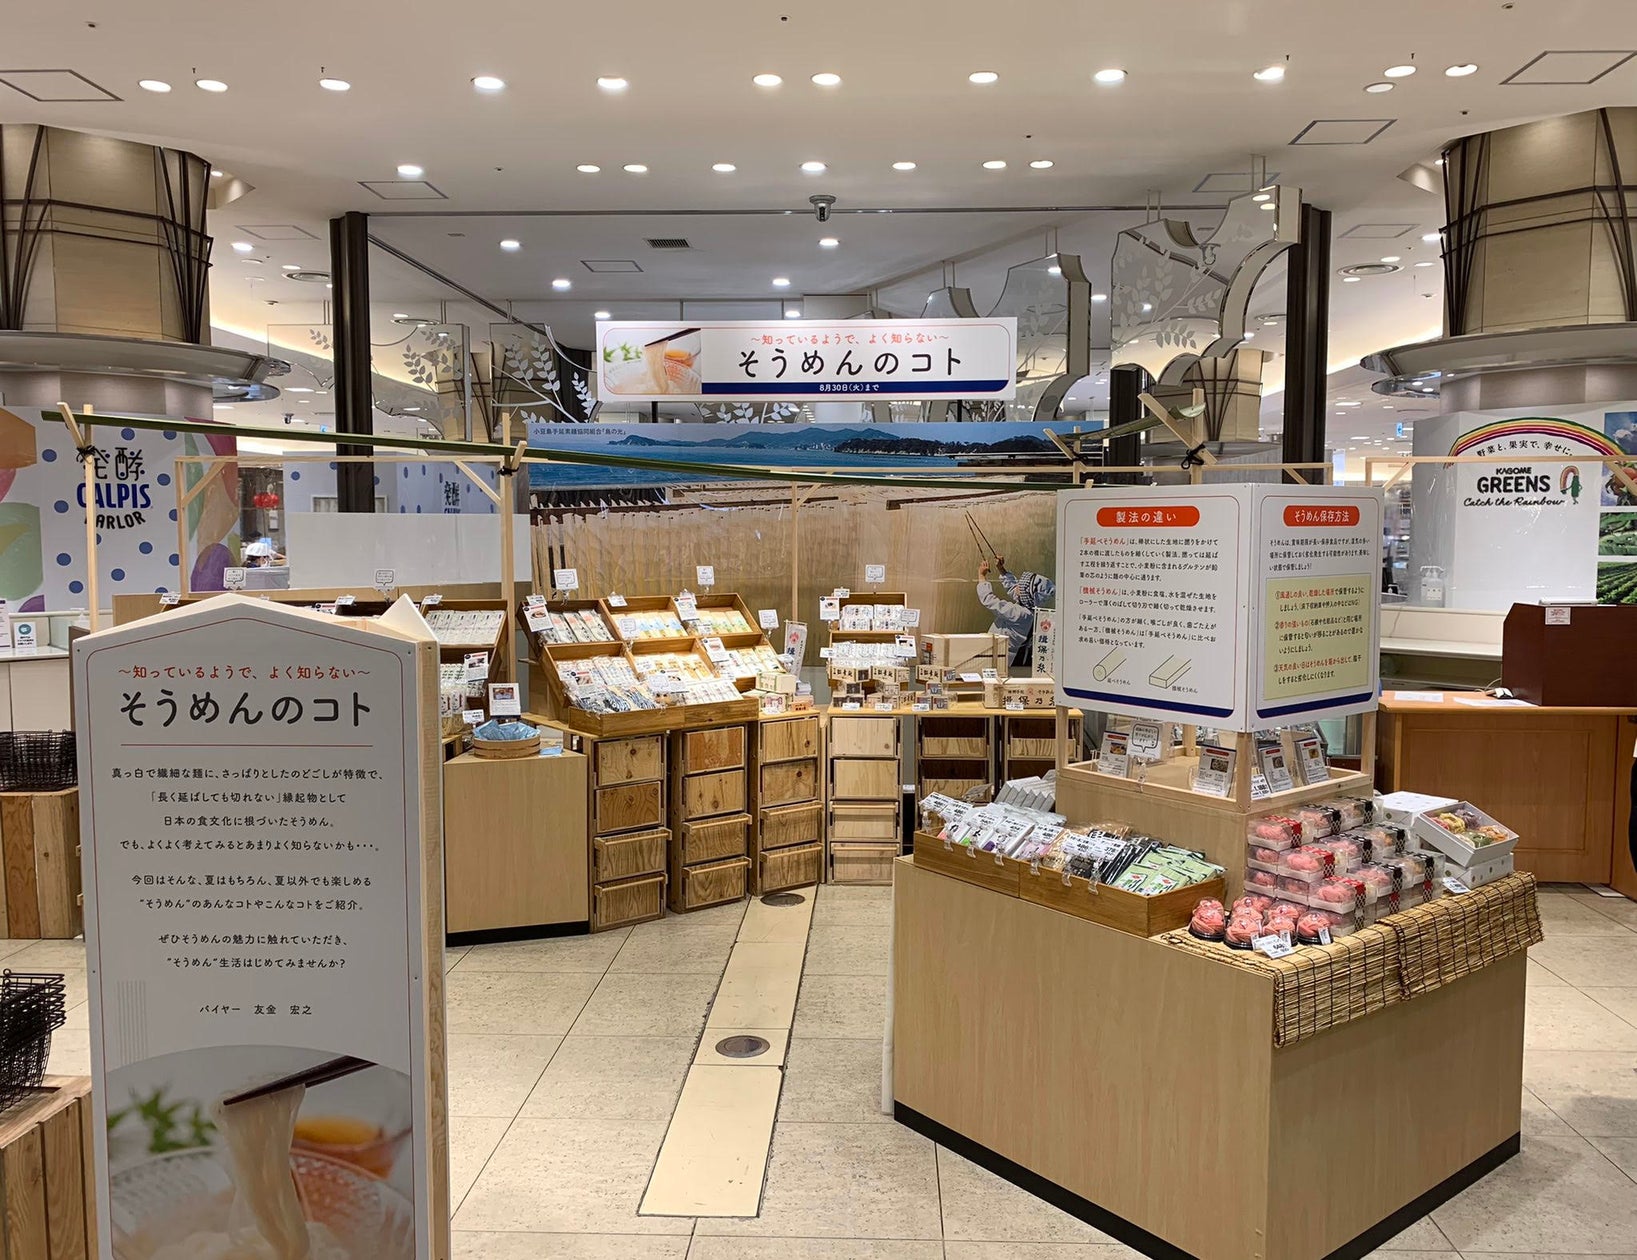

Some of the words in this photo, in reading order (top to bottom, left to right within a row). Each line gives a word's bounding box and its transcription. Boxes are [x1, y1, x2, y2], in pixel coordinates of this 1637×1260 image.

[738, 348, 962, 378] そうめんのコト
[818, 382, 880, 393] 8月30日(火)まで
[1496, 467, 1532, 475] KAGOME
[1476, 475, 1550, 494] GREENS
[1464, 496, 1493, 507] Catch
[1494, 497, 1512, 506] the
[1513, 496, 1566, 507] Rainbow
[84, 511, 146, 530] ARLOR
[1115, 510, 1178, 524] 製法の違い
[1294, 510, 1350, 522] そうめん保存方法
[120, 688, 370, 727] そうめんのコト
[151, 792, 346, 804] 「長く延ばしても切れない」縁起物として
[164, 815, 335, 828] 日本の食文化に根づいたそうめん。
[132, 875, 372, 887] 今回はそんな、夏はもちろん、夏以外でも楽しめる
[158, 934, 348, 946] ぜひそうめんの魅力に触れていただき、
[200, 1004, 241, 1014] バイヤー
[254, 1004, 277, 1014] 友金
[290, 1004, 312, 1014] 宏之
